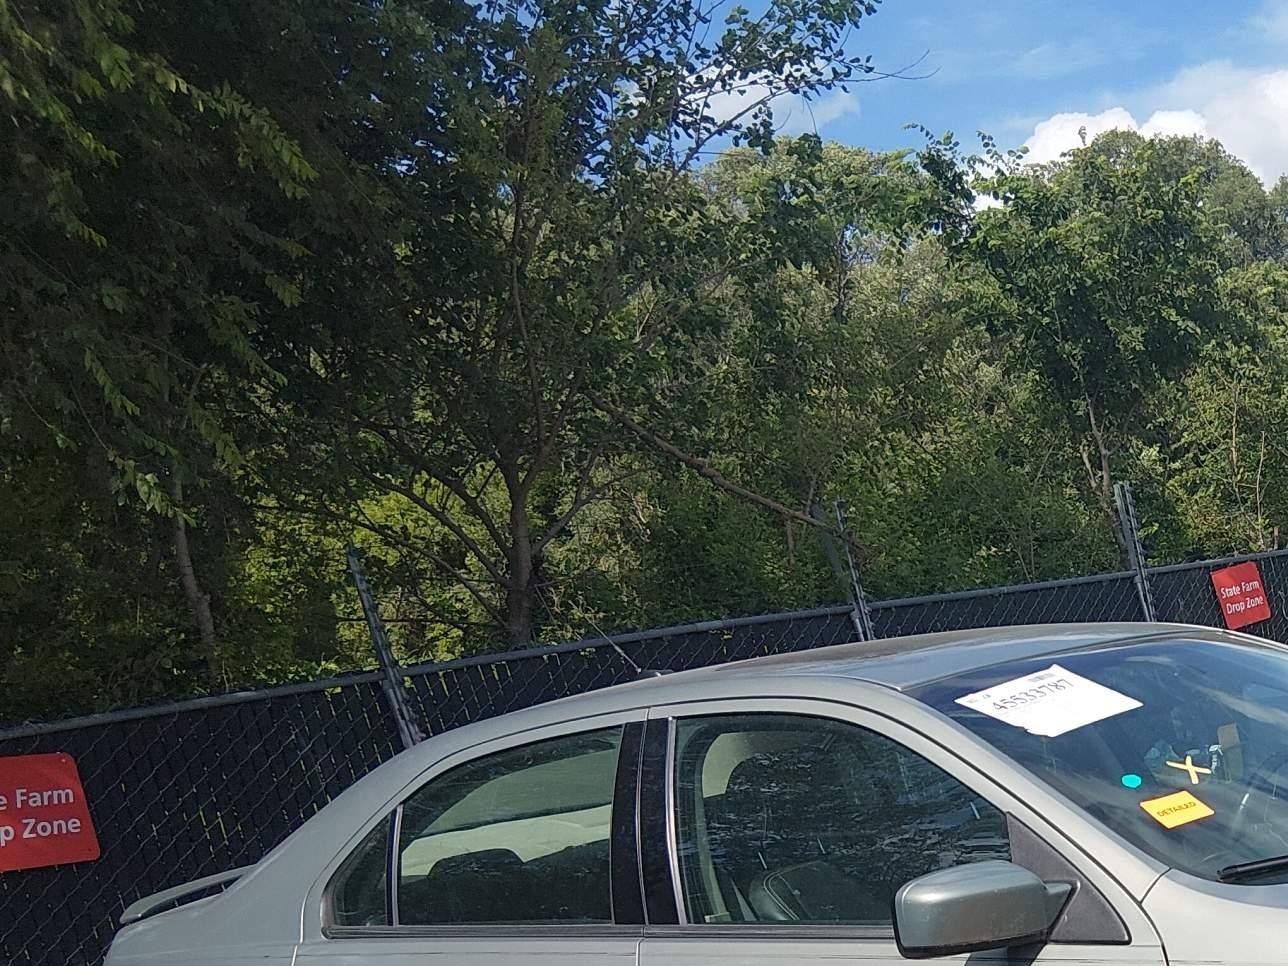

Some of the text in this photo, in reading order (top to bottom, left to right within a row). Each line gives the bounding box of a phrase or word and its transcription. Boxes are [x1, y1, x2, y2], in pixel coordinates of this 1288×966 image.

[1220, 580, 1260, 599] State Farm
[1226, 595, 1264, 614] Drop Zone
[992, 678, 1075, 711] 45533787
[15, 788, 74, 809] Farm
[22, 817, 81, 839] Zone
